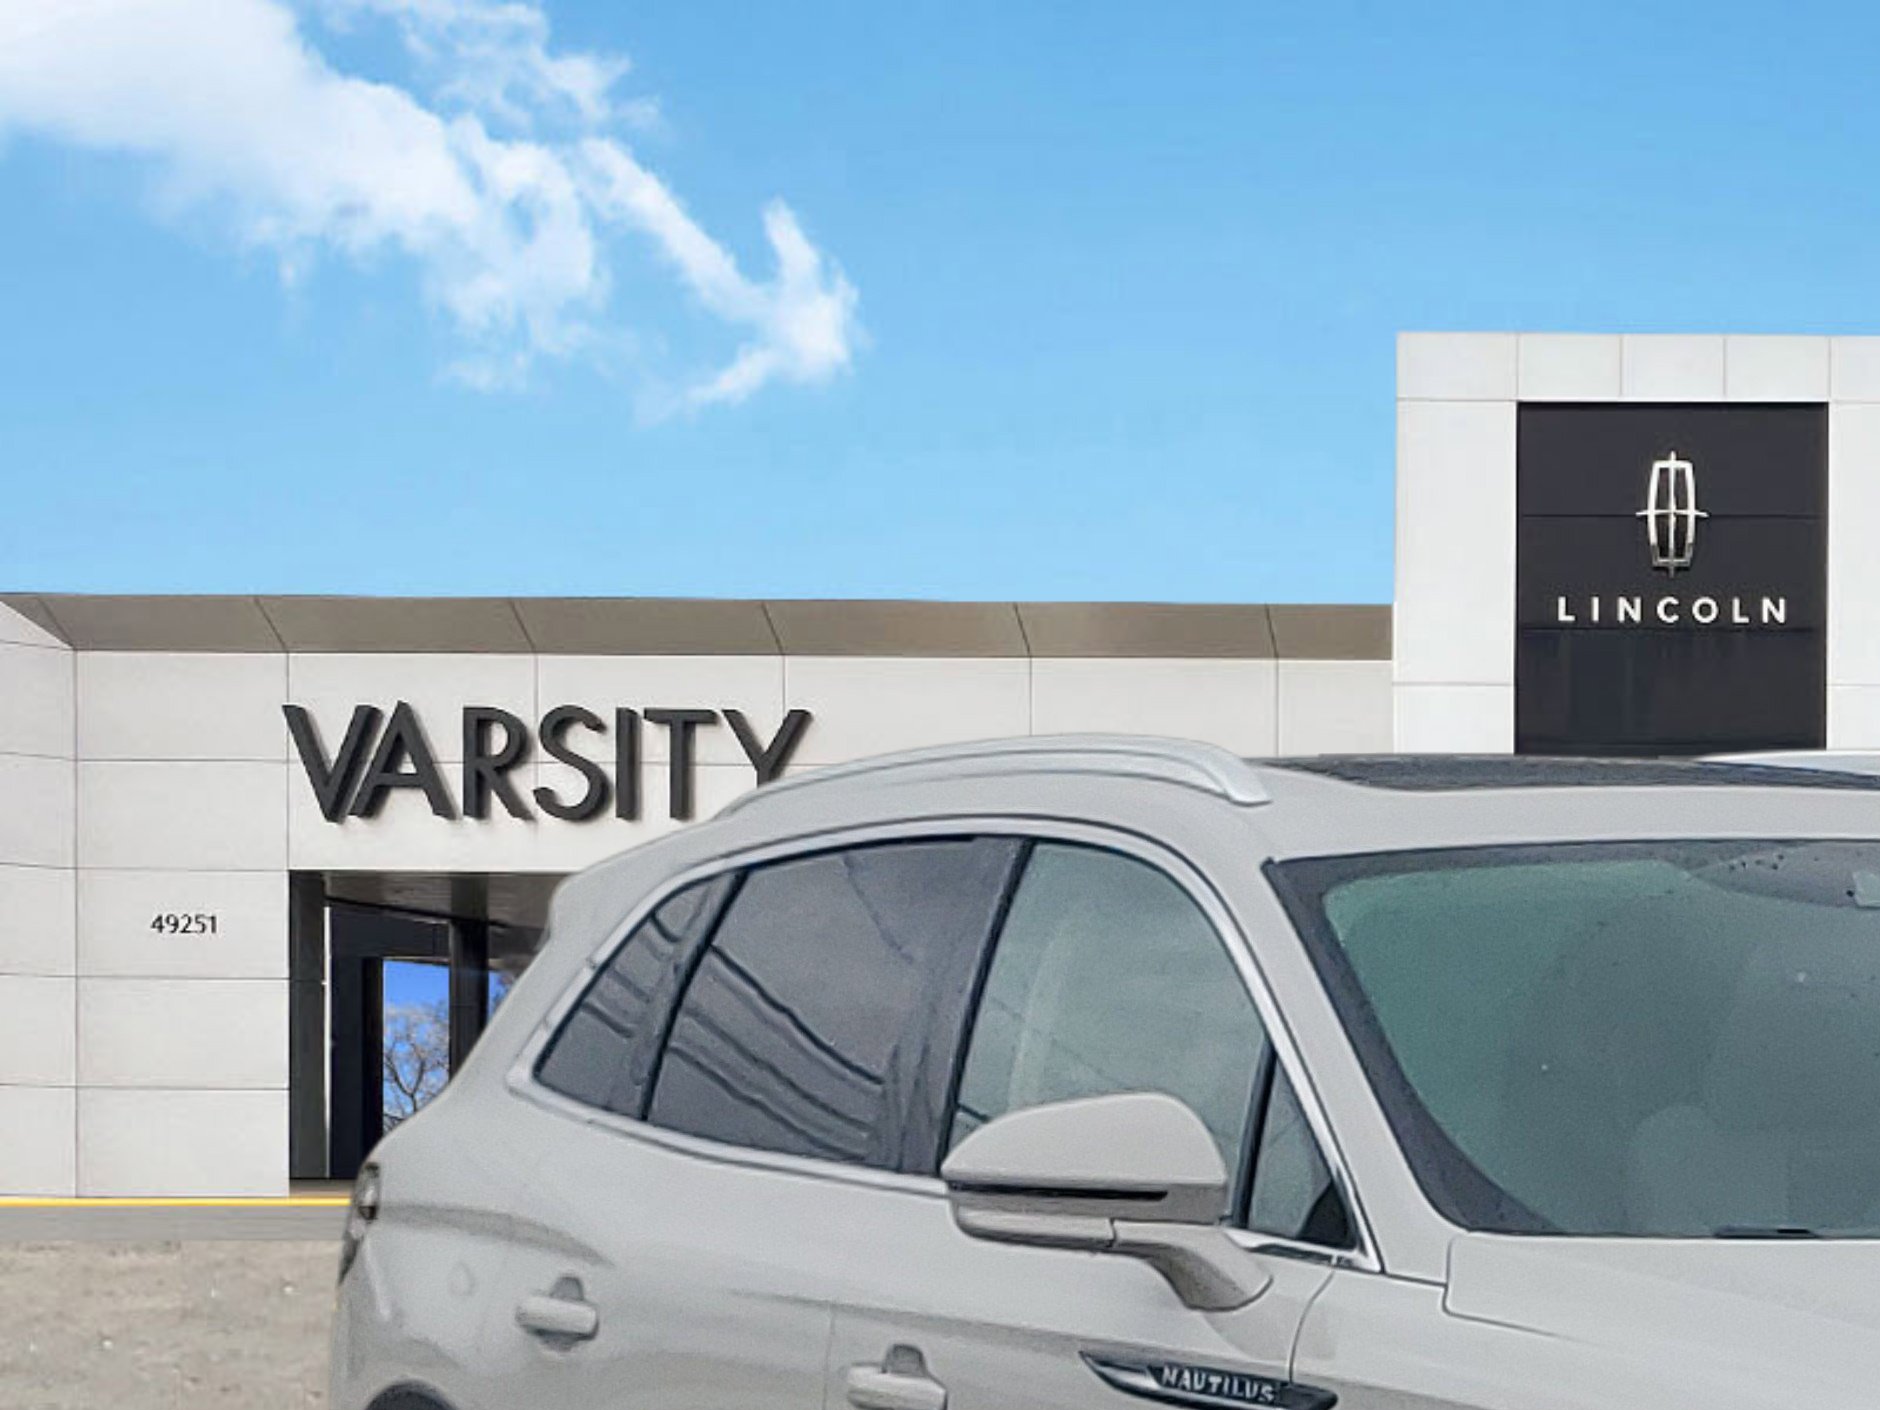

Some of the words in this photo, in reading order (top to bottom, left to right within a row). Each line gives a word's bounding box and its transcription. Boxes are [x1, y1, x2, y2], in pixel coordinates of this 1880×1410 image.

[1557, 596, 1787, 624] LINCOLN
[282, 700, 813, 823] VARSITY
[150, 913, 217, 934] 49251
[1161, 1364, 1275, 1402] NAUTILUS
